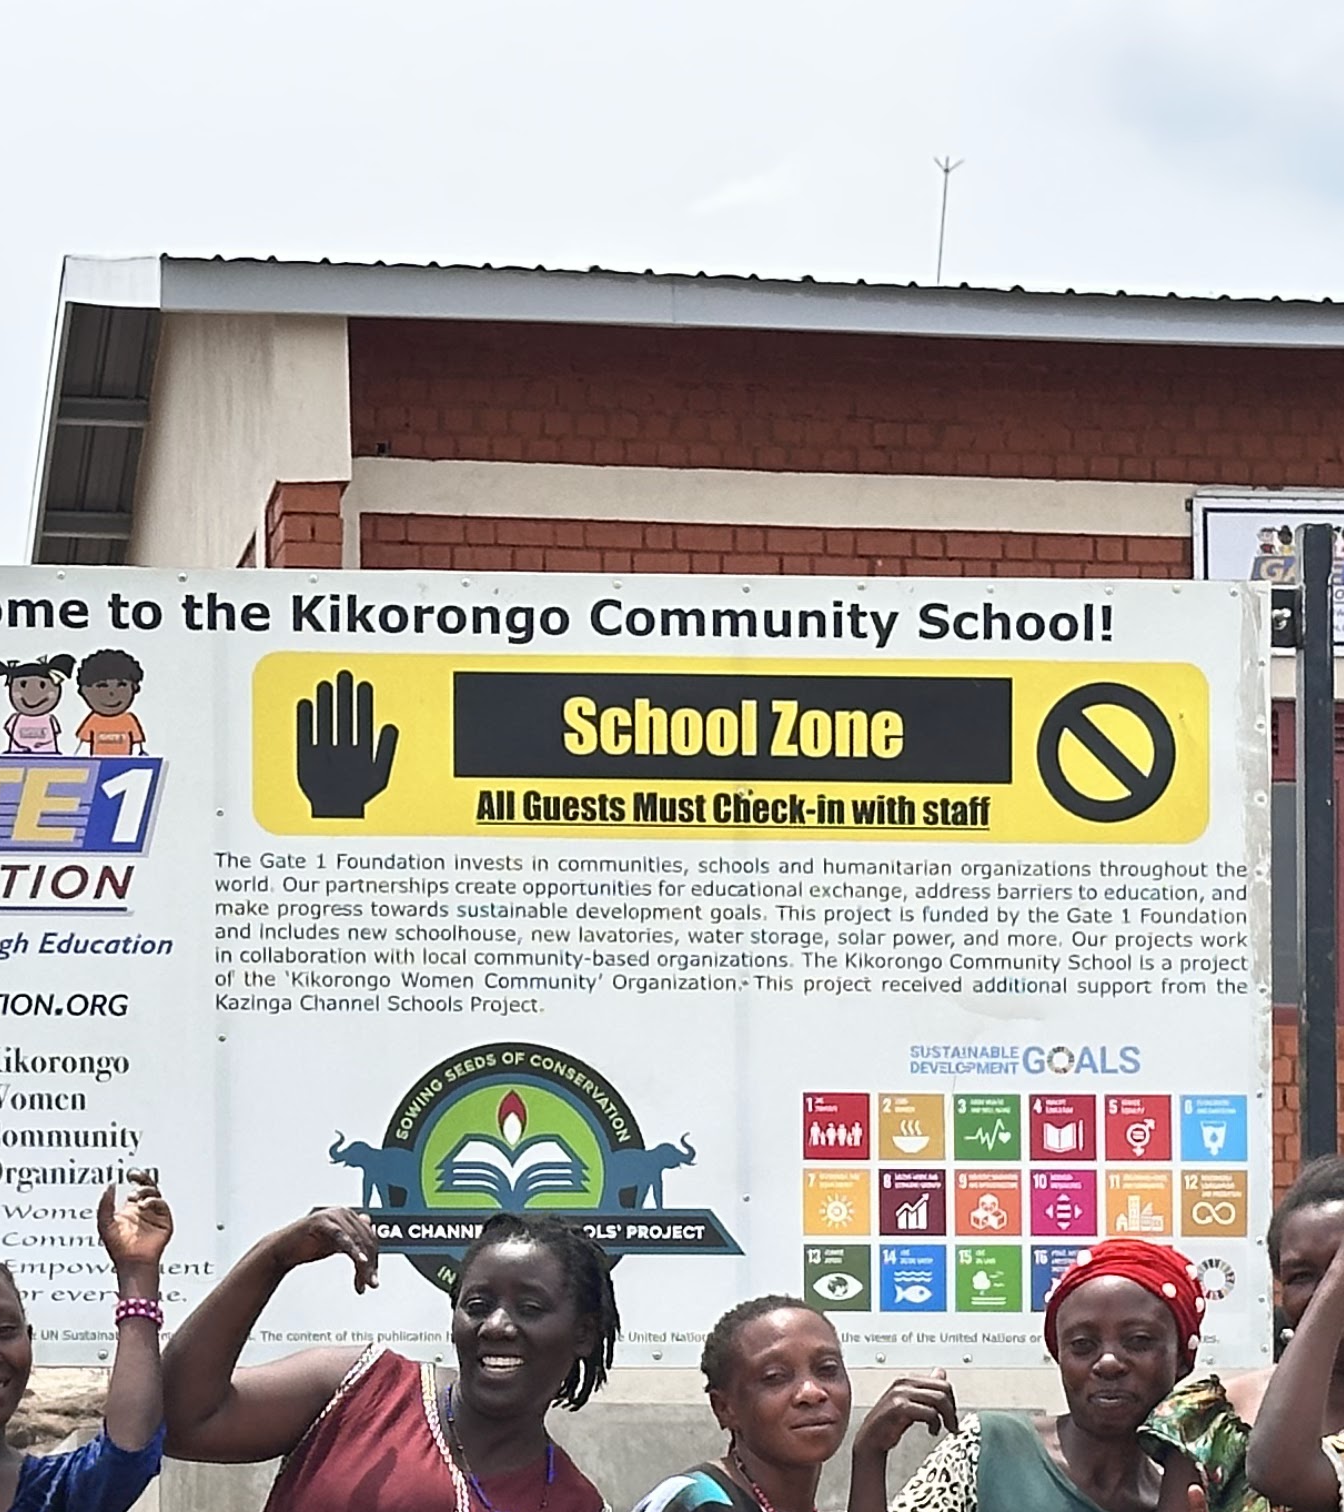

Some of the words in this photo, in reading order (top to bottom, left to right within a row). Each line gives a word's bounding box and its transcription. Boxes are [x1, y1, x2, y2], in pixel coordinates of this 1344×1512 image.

[108, 593, 163, 630] to
[181, 593, 271, 632] the
[291, 594, 570, 645] Kikorongo
[590, 598, 899, 649] Community
[917, 602, 1114, 642] School!
[562, 695, 758, 757] School
[770, 699, 905, 760] Zone
[99, 767, 155, 844] 1
[476, 789, 515, 823] All
[522, 790, 626, 824] Guests
[632, 791, 706, 824] Must
[712, 792, 845, 826] Check-in
[851, 794, 915, 826] with
[922, 795, 991, 827] staff
[212, 850, 253, 871] The
[259, 851, 308, 870] Gate
[315, 852, 328, 870] 1
[336, 852, 446, 871] Foundation
[454, 853, 524, 873] invests
[531, 854, 550, 873] in
[557, 855, 690, 878] communities,
[697, 855, 771, 875] schools
[777, 856, 814, 875] and
[823, 857, 952, 877] humanitarian
[960, 859, 1092, 881] organizations
[1099, 859, 1209, 882] throughout
[1215, 858, 1250, 879] the
[214, 874, 275, 895] world.
[282, 875, 321, 894] Our
[325, 876, 450, 899] partnerships
[454, 877, 517, 896] create
[522, 878, 653, 900] opportunities
[657, 878, 687, 898] for
[690, 879, 803, 899] educational
[808, 880, 909, 904] exchange,
[914, 881, 992, 900] address
[996, 882, 1074, 901] barriers
[1077, 883, 1099, 901] to
[1103, 883, 1205, 905] education,
[1211, 881, 1250, 902] and
[214, 898, 270, 919] make
[277, 902, 364, 921] progress
[370, 899, 450, 918] towards
[455, 900, 569, 920] sustainable
[575, 901, 704, 925] development
[710, 902, 768, 925] goals.
[774, 903, 817, 922] This
[823, 904, 893, 926] project
[899, 905, 915, 923] is
[922, 904, 989, 924] funded
[996, 905, 1021, 928] by
[1027, 906, 1060, 924] the
[1066, 903, 1114, 925] Gate
[1121, 907, 1132, 925] 1
[1140, 906, 1248, 926] Foundation
[38, 931, 174, 956] Education
[214, 920, 252, 942] and
[259, 921, 341, 942] includes
[347, 926, 388, 943] new
[394, 923, 524, 947] schoolhouse,
[530, 928, 572, 944] new
[578, 924, 680, 948] lavatories,
[687, 927, 745, 945] water
[749, 927, 830, 950] storage,
[836, 927, 888, 946] solar
[892, 932, 956, 951] power,
[963, 928, 1000, 948] and
[1007, 933, 1063, 948] more.
[1071, 930, 1109, 948] Our
[1114, 930, 1194, 952] projects
[1199, 930, 1249, 948] work
[214, 944, 233, 965] in
[239, 945, 367, 966] collaboration
[373, 946, 416, 966] with
[422, 946, 467, 967] local
[473, 948, 650, 971] community-based
[656, 950, 795, 973] organizations.
[800, 950, 839, 969] The
[845, 949, 943, 974] Kikorongo
[948, 952, 1062, 975] Community
[1067, 952, 1132, 972] School
[1139, 953, 1155, 972] is
[1160, 957, 1173, 972] a
[1179, 953, 1250, 976] project
[214, 968, 236, 988] of
[243, 969, 277, 988] the
[400, 970, 475, 990] Women
[612, 972, 743, 995] Organization.
[753, 974, 794, 992] This
[803, 975, 873, 997] project
[881, 975, 963, 994] received
[971, 975, 1068, 995] additional
[1076, 979, 1154, 999] support
[1160, 976, 1207, 995] from
[1216, 977, 1249, 996] the
[215, 991, 293, 1016] Kazinga
[299, 993, 380, 1013] Channel
[386, 994, 464, 1013] Schools
[470, 995, 545, 1017] Project.
[910, 1045, 1020, 1059] SUSTAINABLE
[1022, 1046, 1141, 1075] GOALS
[910, 1061, 1020, 1075] DEVELOPMENT
[396, 1078, 443, 1140] SOWING
[444, 1053, 497, 1082] SEEDS
[501, 1051, 525, 1066] OF
[529, 1054, 631, 1143] CONSERVATION
[882, 1098, 891, 1113] 2
[957, 1099, 966, 1114] 3
[1033, 1098, 1042, 1114] 4
[1109, 1099, 1118, 1115] 5
[1033, 1174, 1047, 1189] 10
[1184, 1175, 1198, 1190] 12
[1, 1204, 97, 1220] Wome
[626, 1225, 705, 1239] PROJECT
[883, 1249, 897, 1265] 14
[41, 1330, 58, 1341] UN
[260, 1330, 283, 1342] The
[286, 1331, 331, 1342] content
[335, 1330, 348, 1342] of
[351, 1330, 374, 1342] this
[377, 1330, 442, 1345] publication
[628, 1330, 667, 1342] United
[841, 1332, 860, 1343] the
[901, 1331, 914, 1343] of
[916, 1332, 936, 1343] the
[939, 1332, 977, 1343] United
[982, 1332, 1026, 1343] Nations
[1029, 1334, 1042, 1343] or
